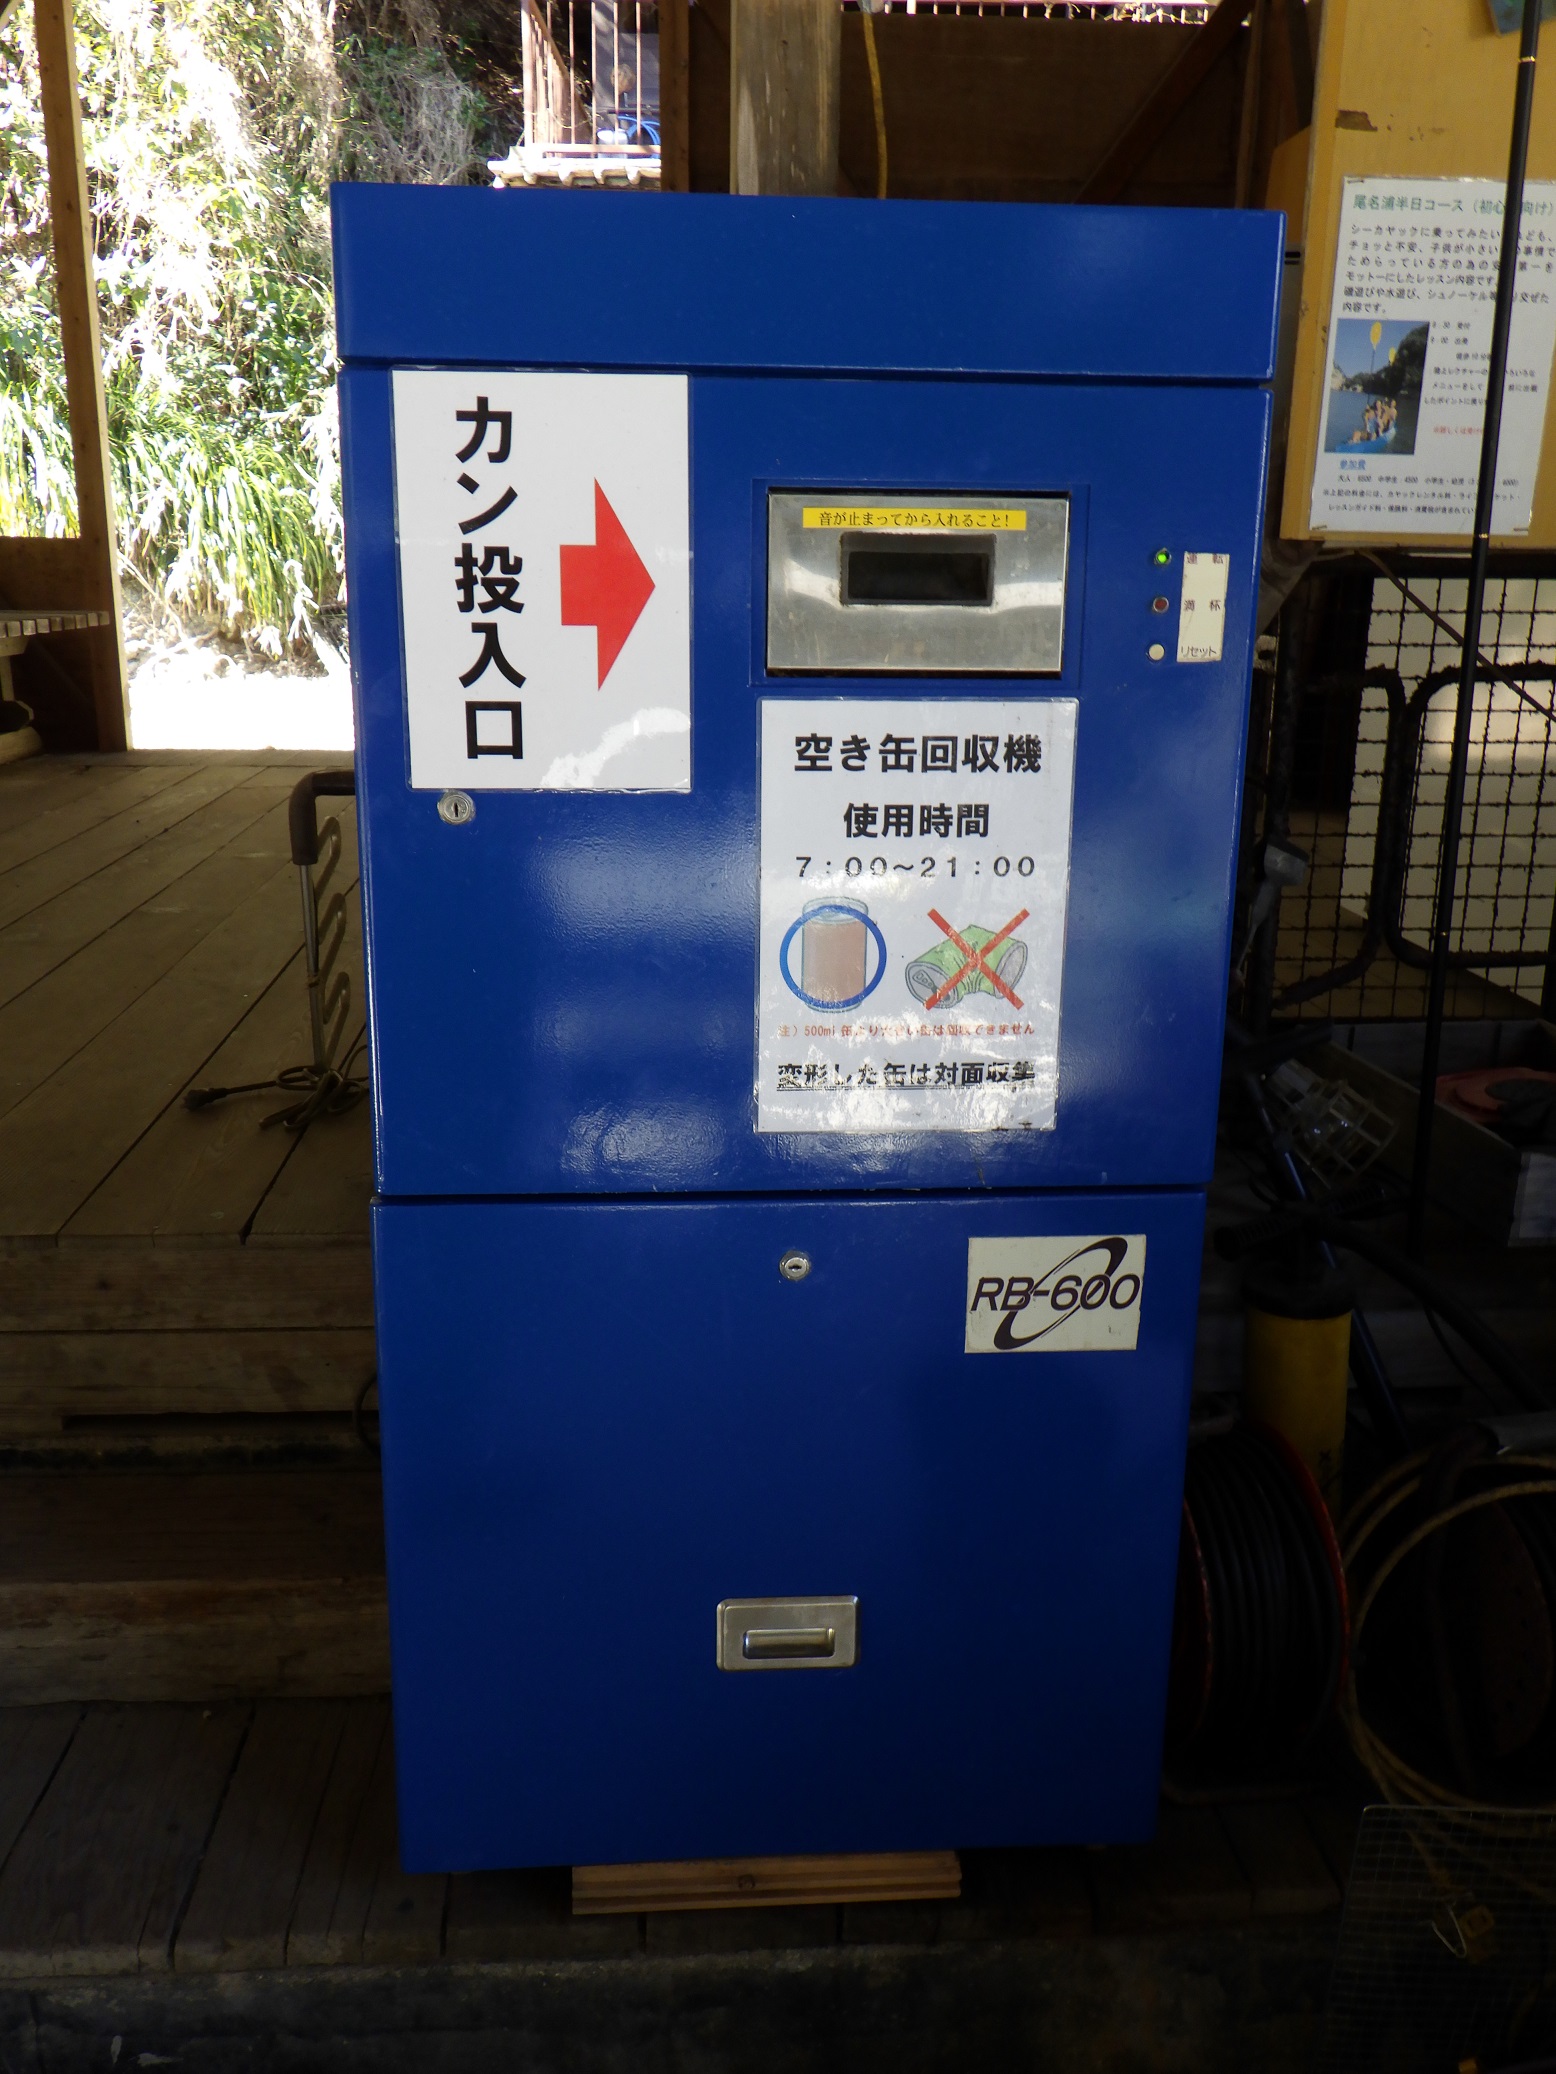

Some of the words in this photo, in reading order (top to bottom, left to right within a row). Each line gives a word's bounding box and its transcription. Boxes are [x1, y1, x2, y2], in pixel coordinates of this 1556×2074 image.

[1473, 198, 1553, 216] （初心向け）
[818, 511, 1010, 528] 音が止まってから入れること!
[454, 396, 527, 759] カン投入口
[1181, 645, 1217, 658] リセット
[794, 733, 1042, 773] 空き缶回収機
[843, 803, 990, 838] 使用時間
[971, 1274, 1140, 1311] RB-600
